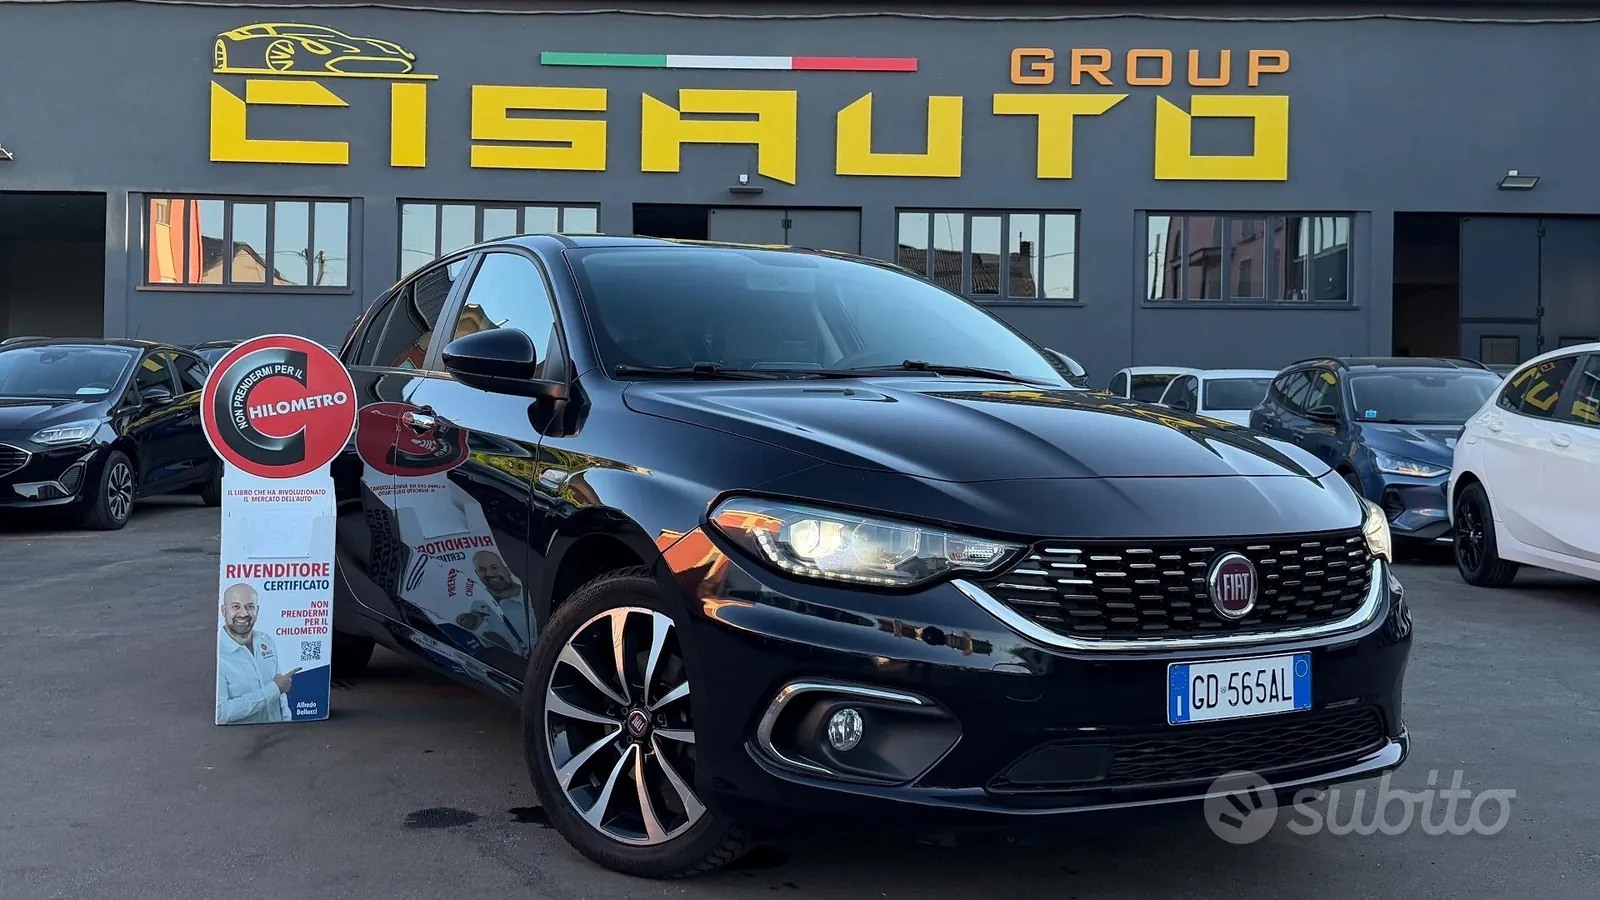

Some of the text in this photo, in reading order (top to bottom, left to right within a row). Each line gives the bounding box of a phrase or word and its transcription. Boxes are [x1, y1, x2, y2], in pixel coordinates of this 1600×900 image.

[1010, 47, 1290, 87] GROUP
[210, 79, 1290, 185] CISAUTO
[234, 364, 304, 430] NON PRENDERMI PER IL
[226, 562, 330, 579] RIVENDITORE
[263, 579, 330, 591] CERTIFICATO
[1223, 572, 1250, 601] FIAT
[310, 600, 329, 608] NON
[281, 609, 328, 618] PRENDERMI
[321, 618, 329, 626] IL
[275, 626, 328, 635] CHILOMETRO
[1192, 667, 1293, 710] GD 565AL
[296, 708, 318, 716] Bellucci
